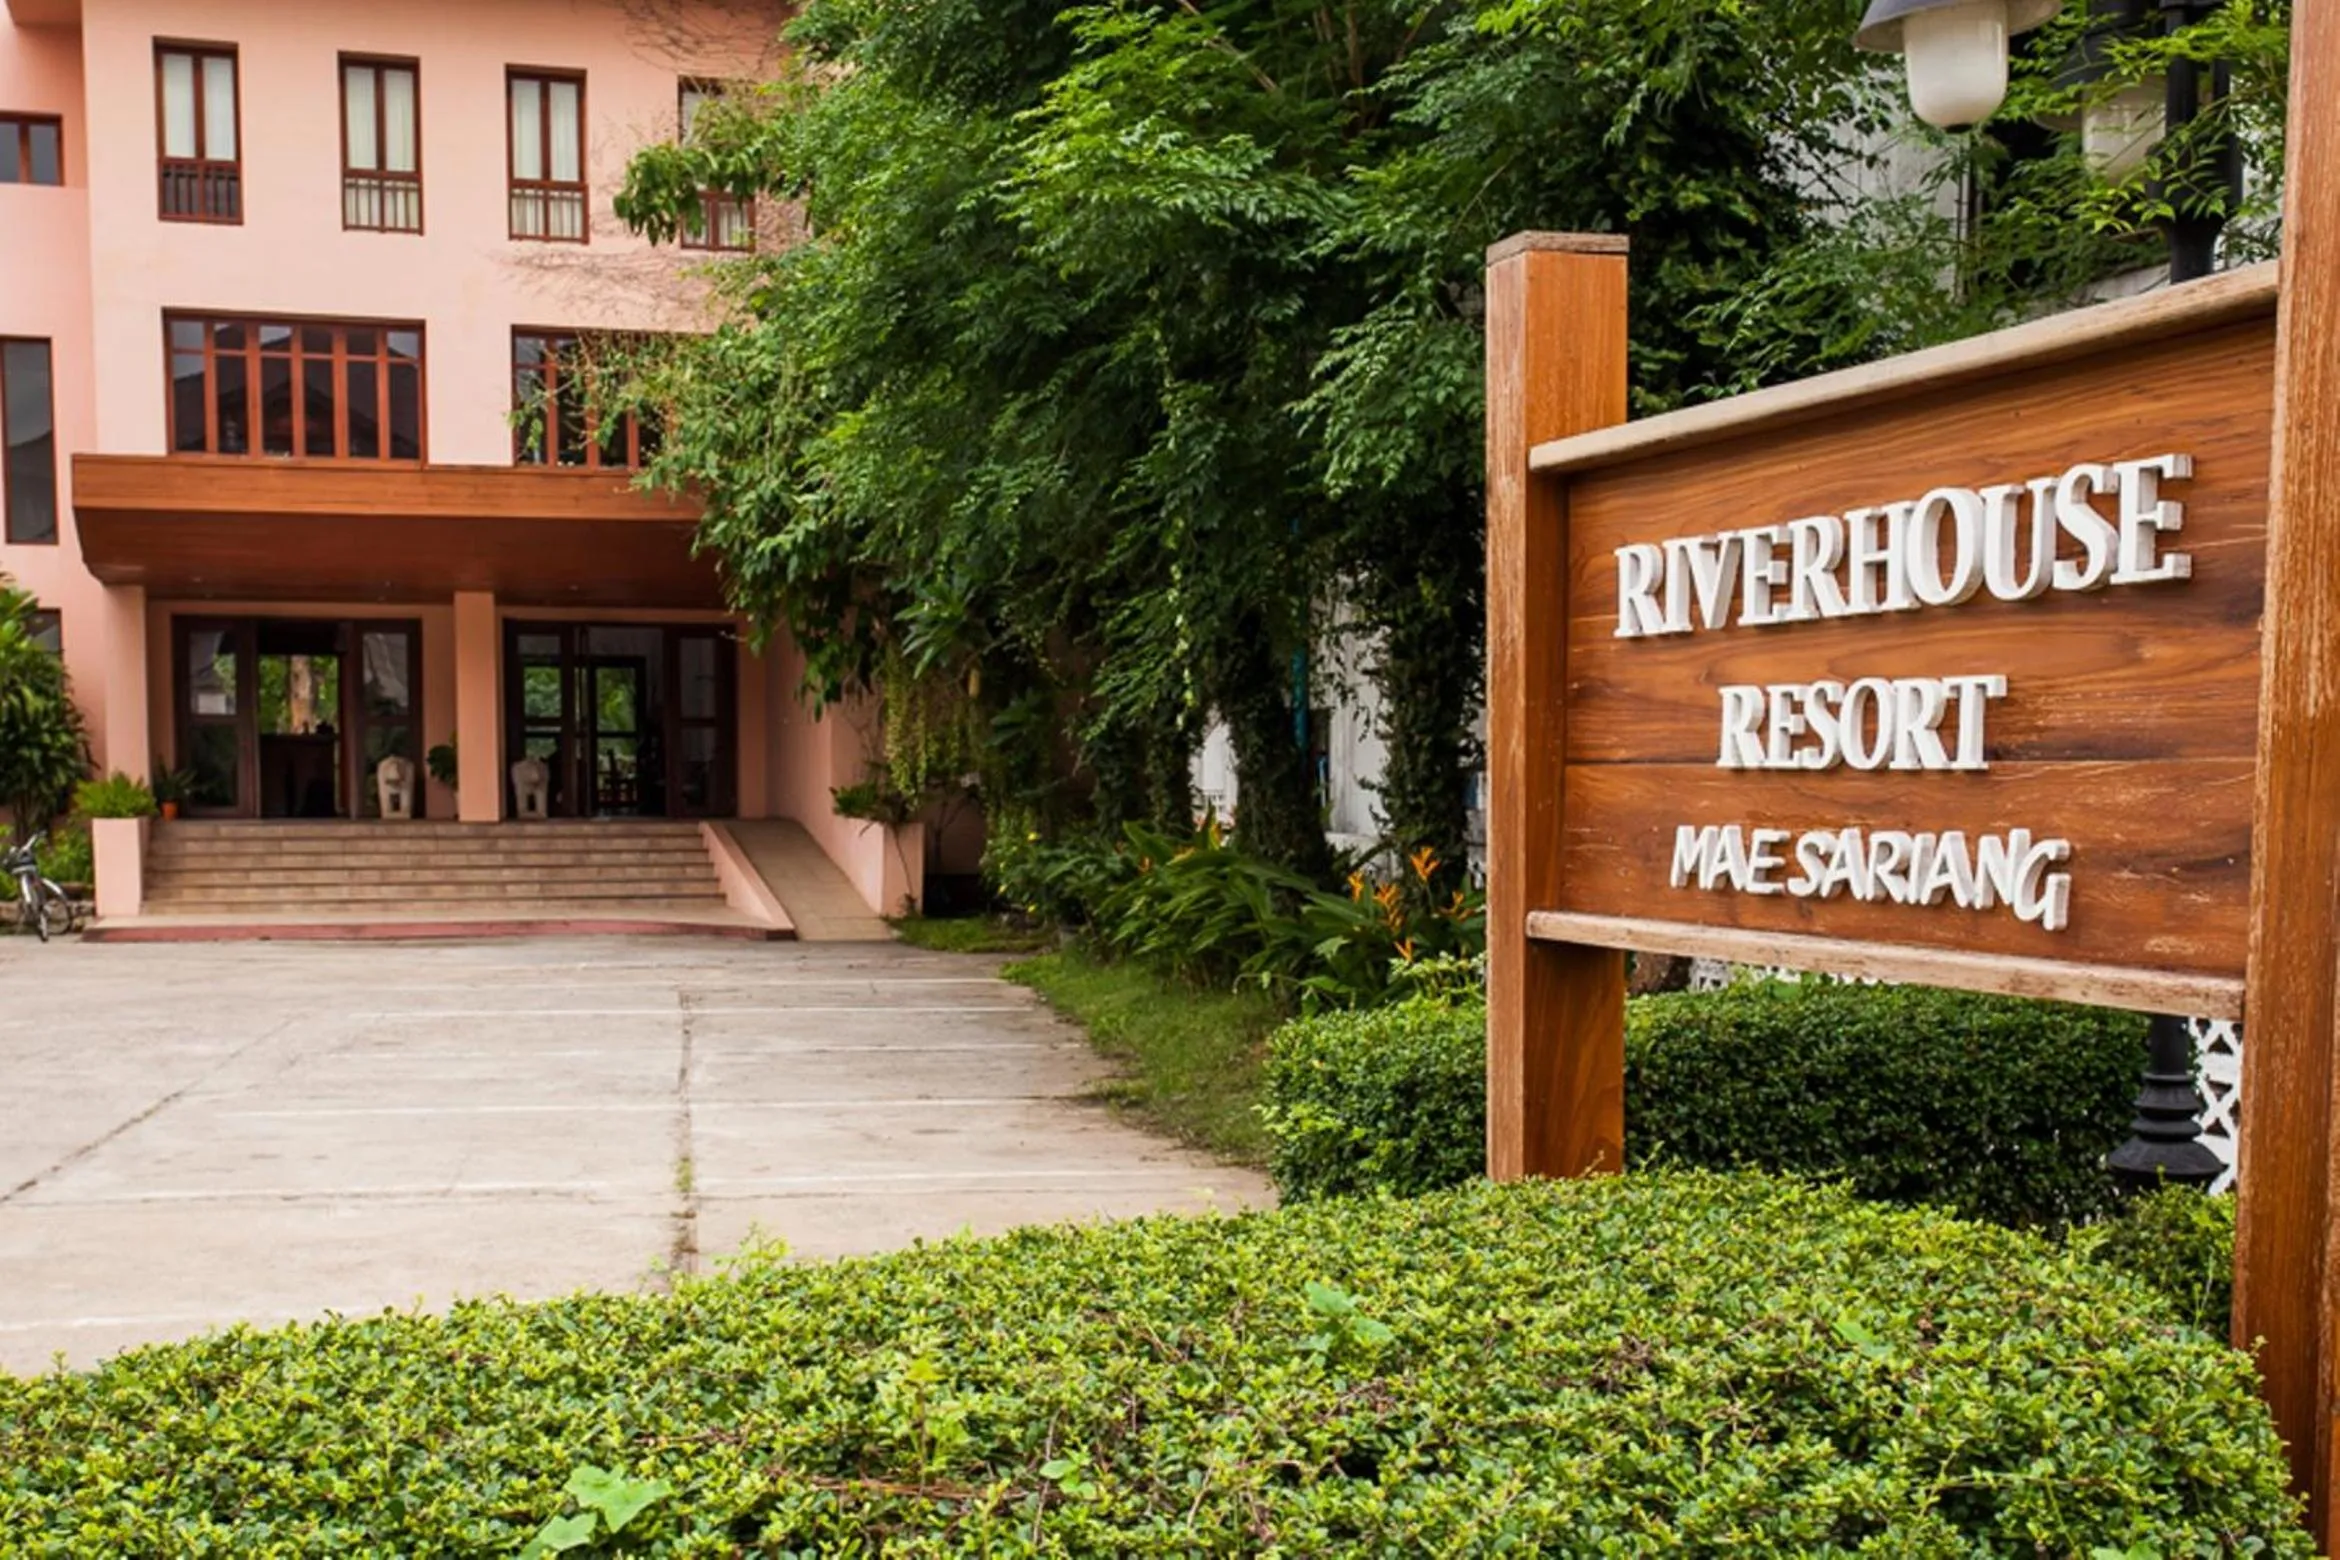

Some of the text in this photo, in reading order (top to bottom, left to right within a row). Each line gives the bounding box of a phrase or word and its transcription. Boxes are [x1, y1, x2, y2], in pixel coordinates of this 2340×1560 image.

[1614, 453, 2194, 639] RIVERHOUSE
[1716, 674, 2008, 771] RESORT
[1669, 824, 2072, 932] MAE SARIANG
